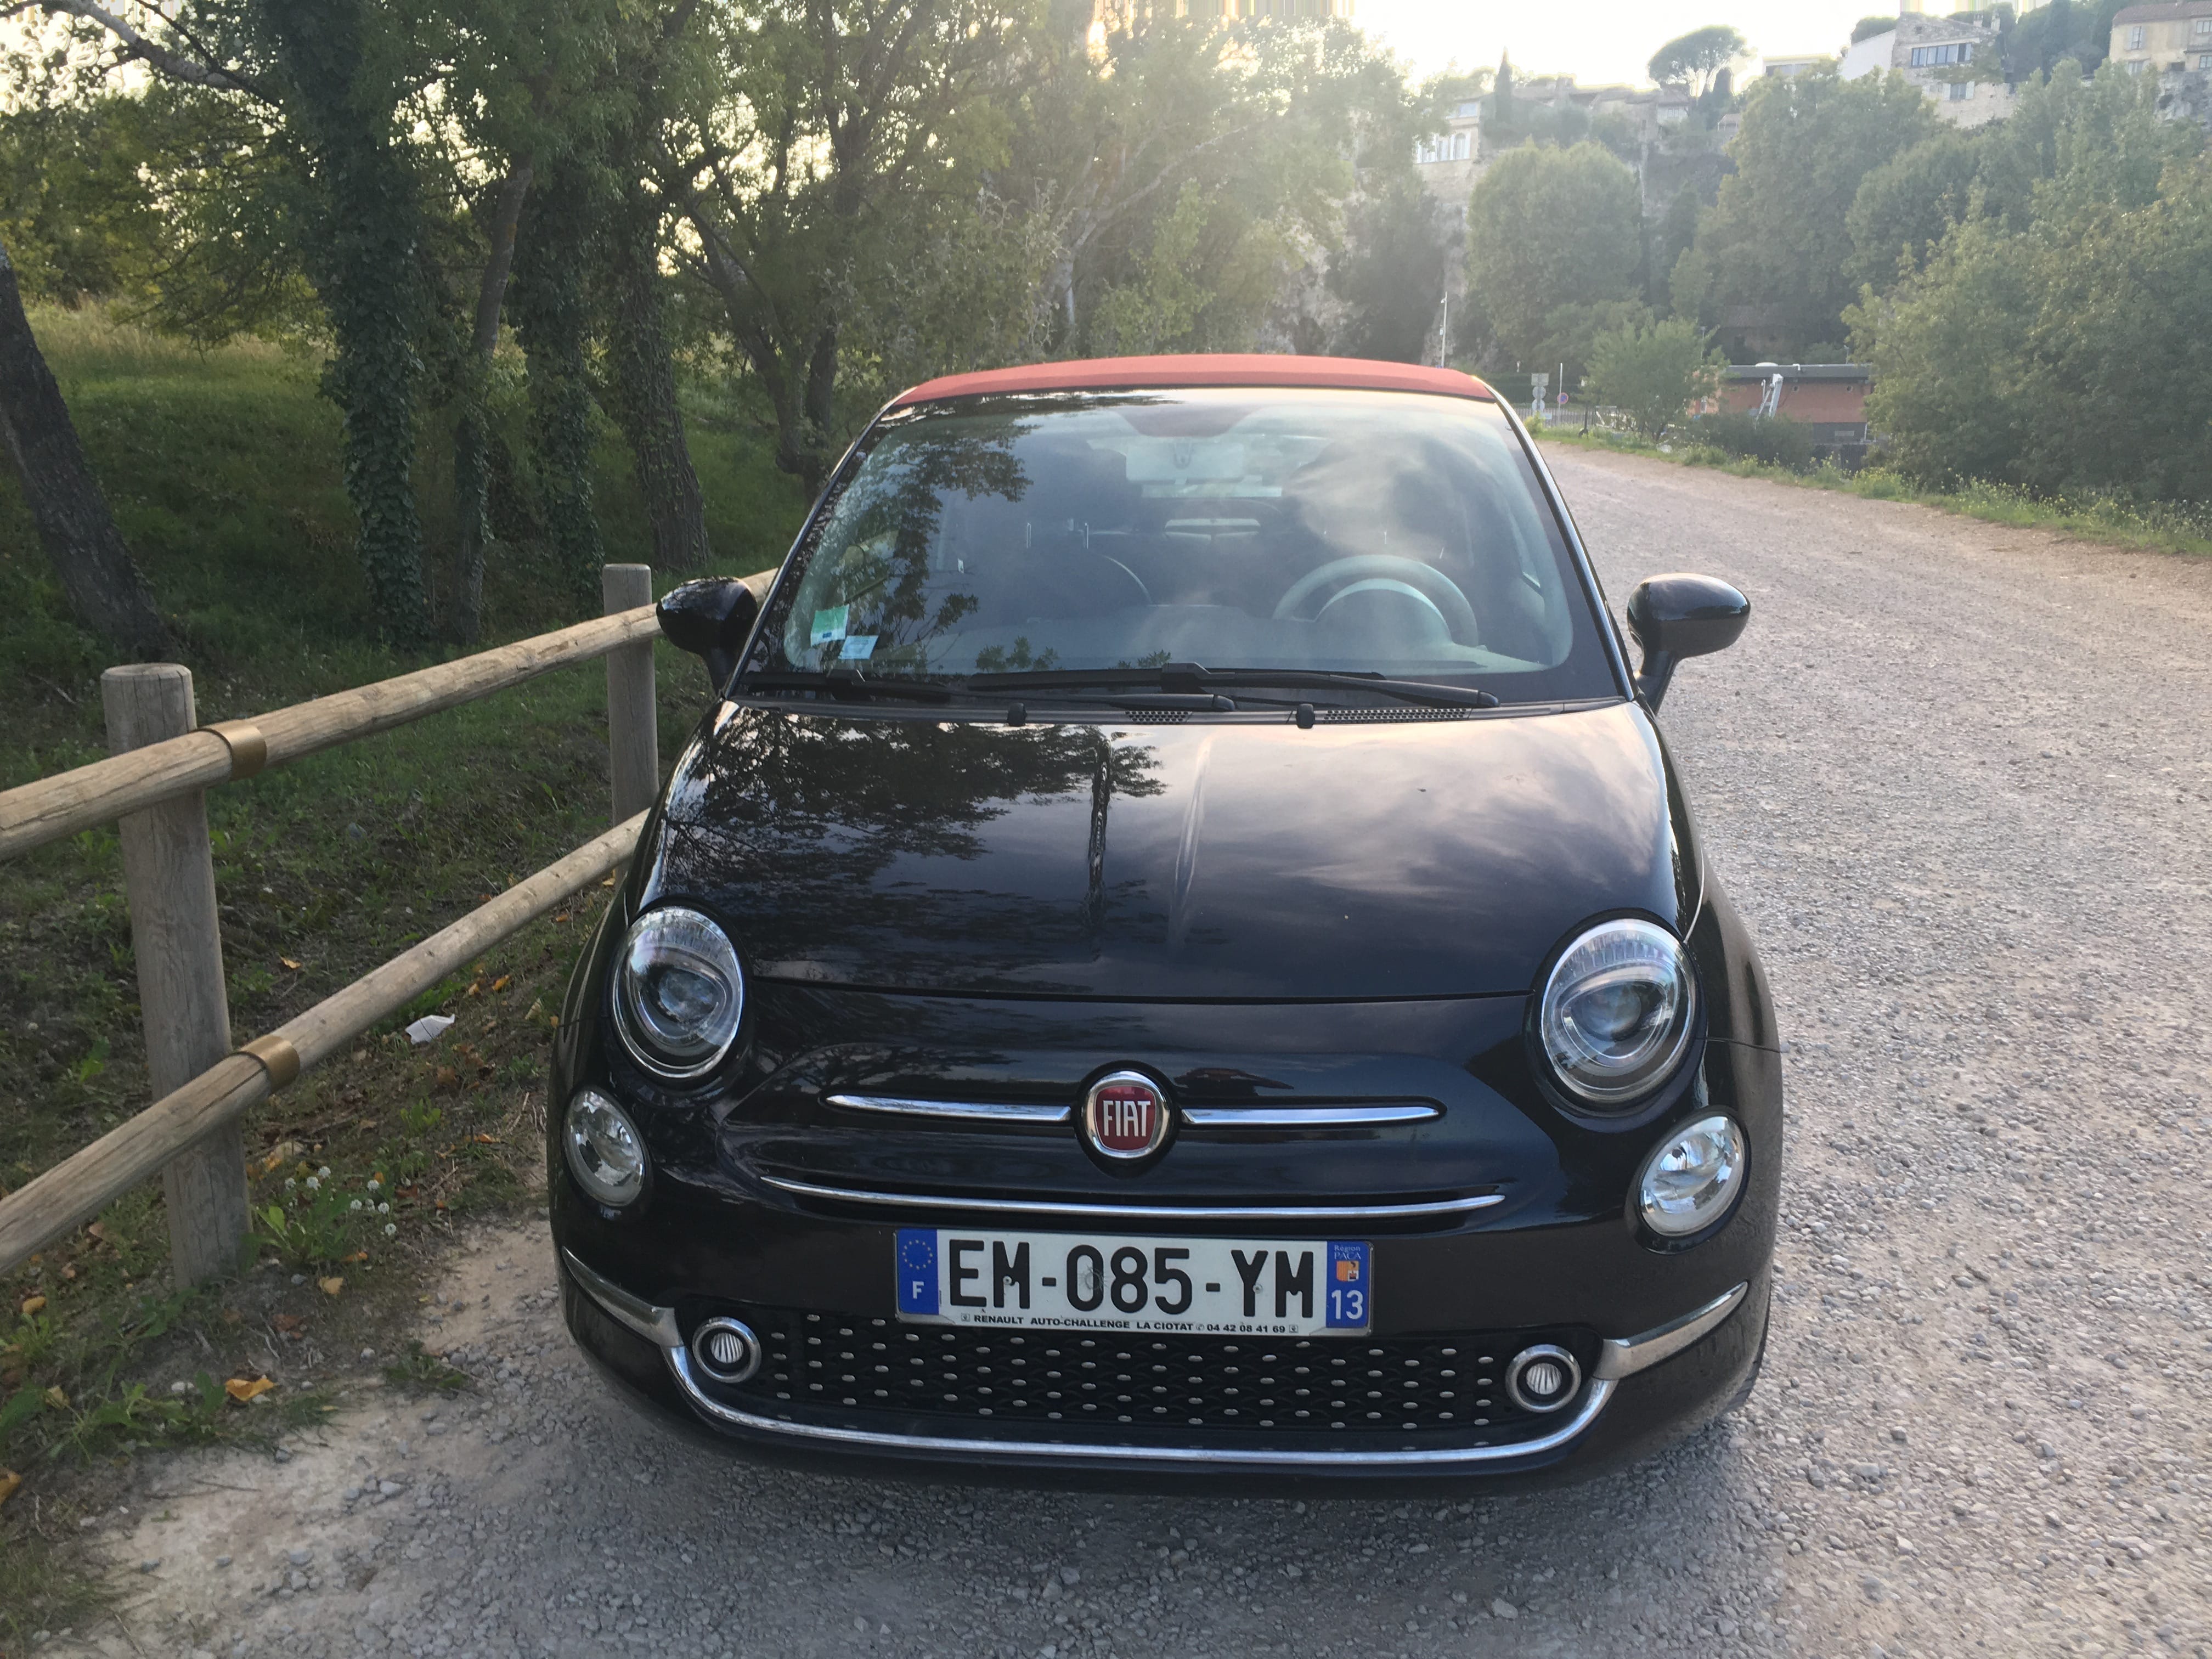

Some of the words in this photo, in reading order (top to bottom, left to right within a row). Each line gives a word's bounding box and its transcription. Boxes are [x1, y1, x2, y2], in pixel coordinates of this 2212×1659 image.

[1103, 1100, 1151, 1137] FIAT
[1334, 1251, 1362, 1260] PACA
[912, 1280, 924, 1299] F
[949, 1239, 1314, 1318] EM-085-YM
[1331, 1289, 1363, 1320] 13
[974, 1314, 1024, 1324] RENAULT
[1030, 1317, 1130, 1329] AUTO-CHALLENGE
[1154, 1322, 1194, 1331] CIOTAT
[1256, 1325, 1268, 1333] 41
